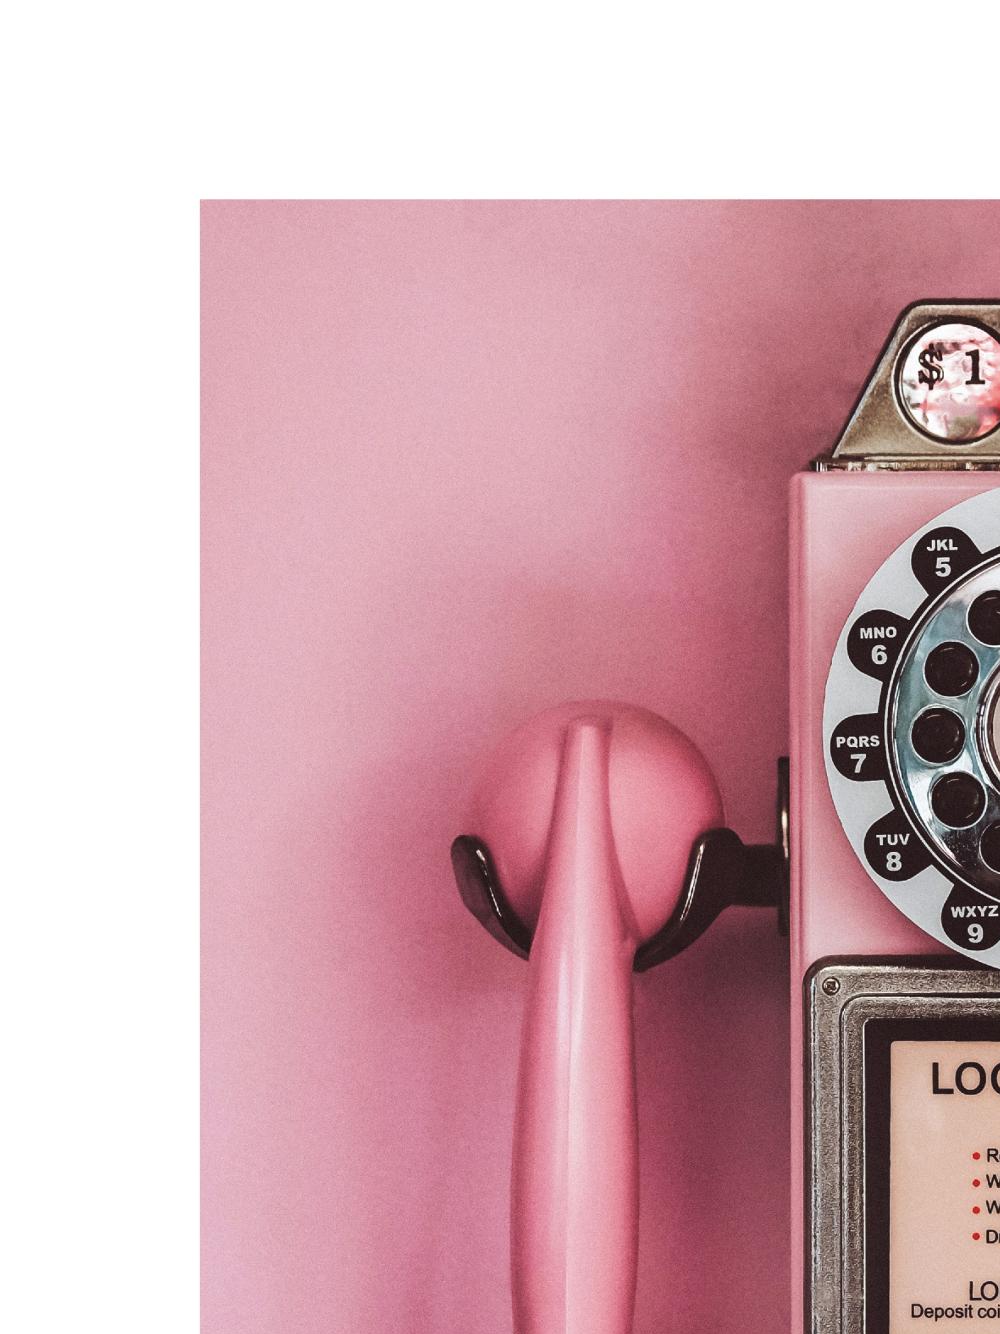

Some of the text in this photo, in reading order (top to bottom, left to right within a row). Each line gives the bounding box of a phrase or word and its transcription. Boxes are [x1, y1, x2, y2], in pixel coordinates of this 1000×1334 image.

[917, 344, 986, 390] $ 1
[926, 538, 959, 552] JKL
[935, 556, 952, 578] 5
[859, 626, 897, 640] MNO
[871, 644, 888, 665] 6
[836, 735, 880, 749] PQRS
[850, 753, 867, 774] 7
[875, 833, 911, 846] TUV
[886, 851, 902, 872] 8
[950, 904, 1000, 918] WXYZ
[967, 923, 984, 944] 9
[911, 1303, 974, 1322] Deposit
